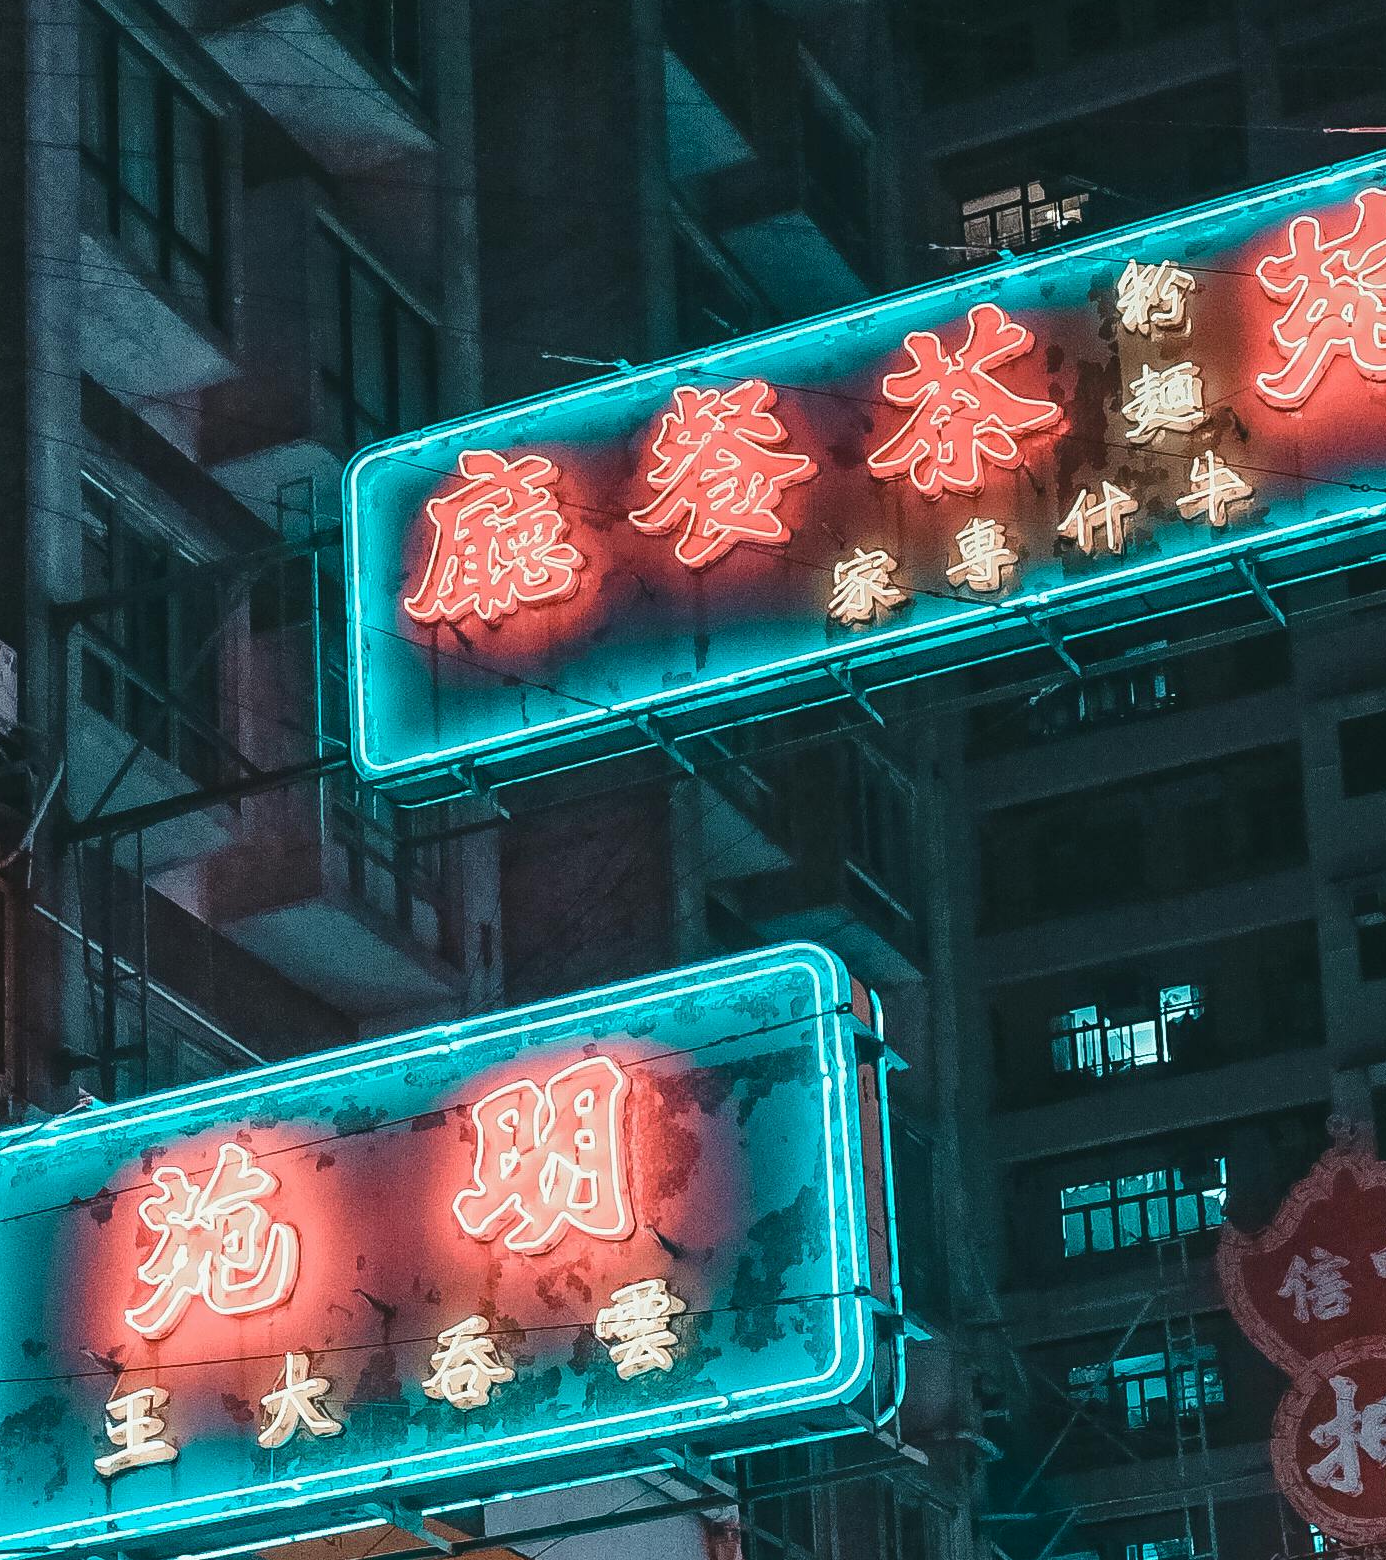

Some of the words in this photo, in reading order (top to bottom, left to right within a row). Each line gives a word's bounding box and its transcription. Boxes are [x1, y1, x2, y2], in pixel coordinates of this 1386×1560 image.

[124, 1055, 638, 1340] 明苑
[94, 1278, 687, 1477] 雲吞大王
